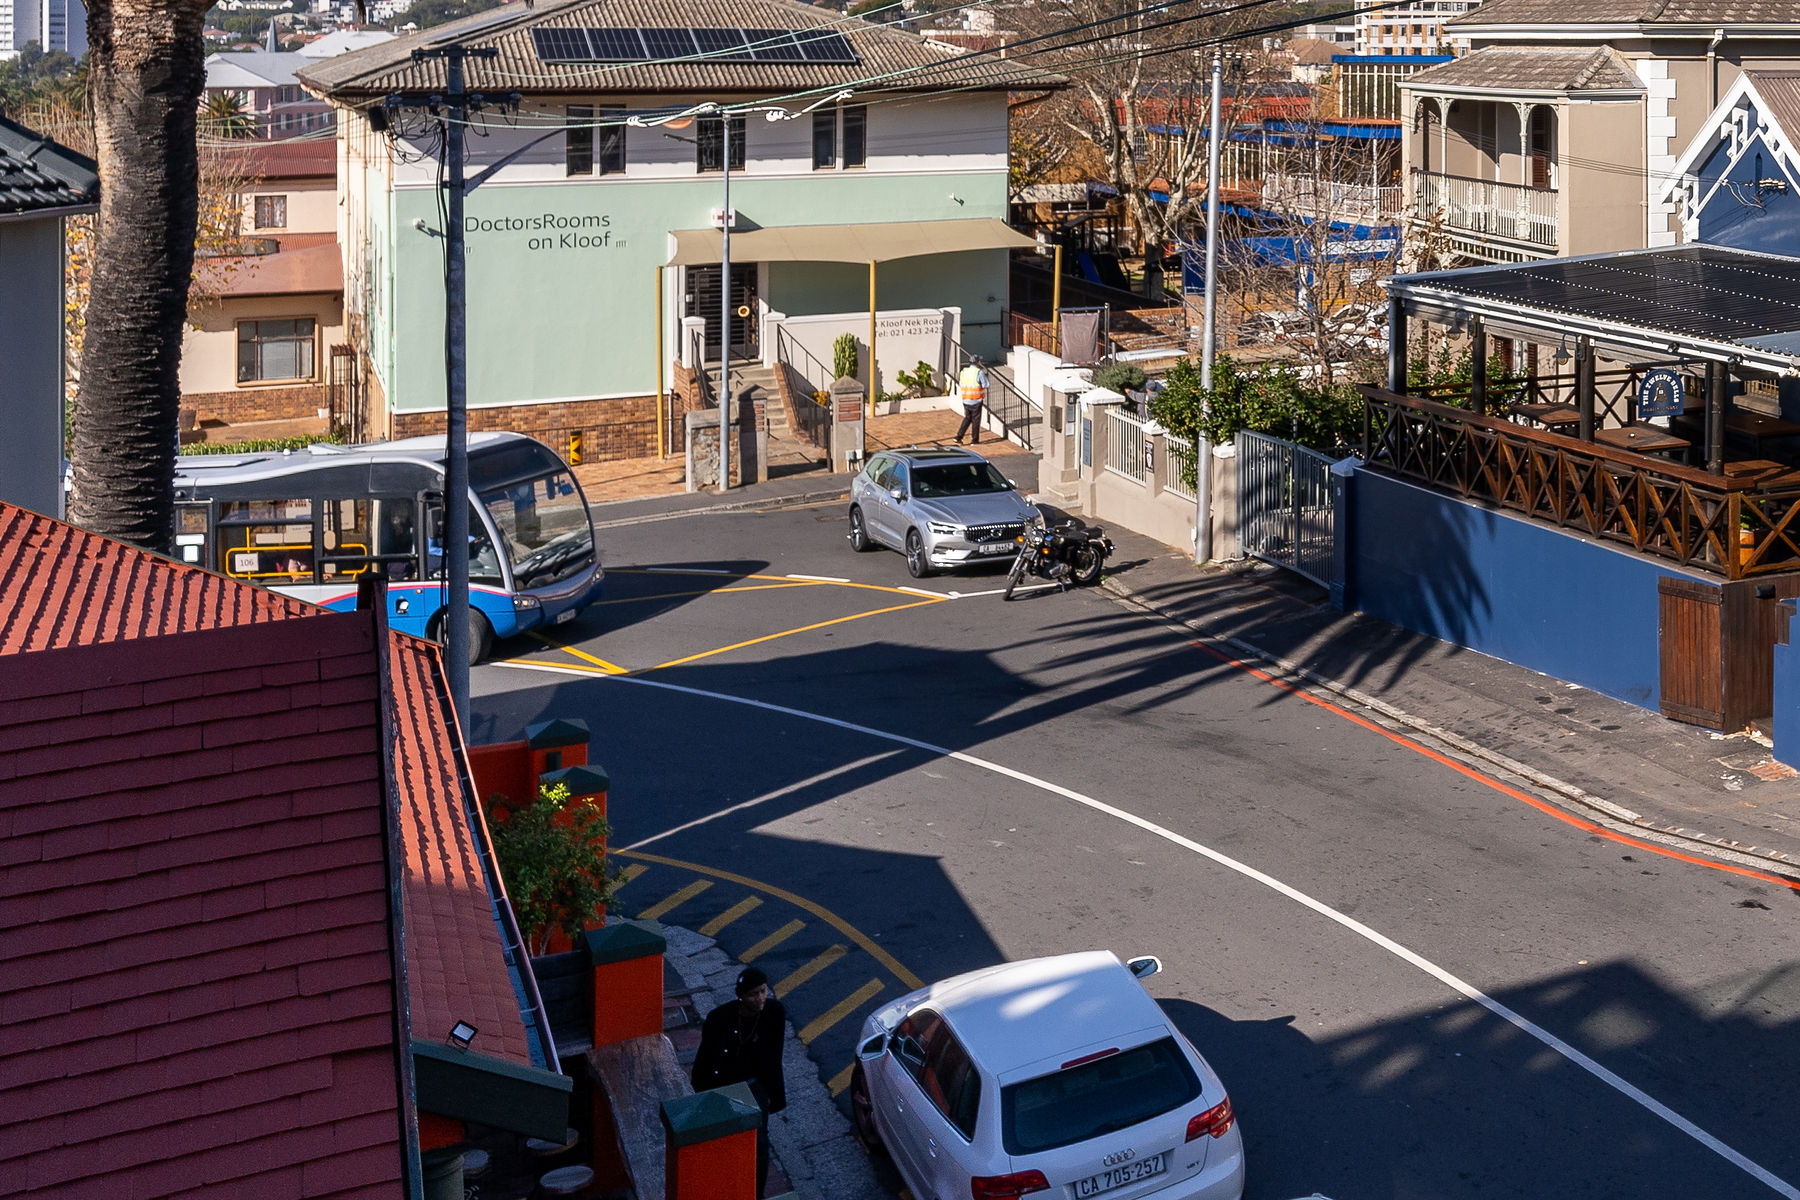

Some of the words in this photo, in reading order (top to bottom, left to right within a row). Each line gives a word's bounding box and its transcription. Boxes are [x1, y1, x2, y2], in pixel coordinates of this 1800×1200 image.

[465, 213, 611, 233] DoctorsRooms
[528, 236, 553, 251] on
[559, 230, 611, 249] Kloof
[880, 320, 902, 328] Kloof
[905, 318, 921, 326] Nek
[890, 329, 905, 337] 021
[1645, 374, 1672, 389] TWELVE
[1642, 389, 1650, 406] THE
[1670, 379, 1680, 403] BELLS
[1081, 1179, 1099, 1195] CA
[1104, 1156, 1160, 1191] 705-257
